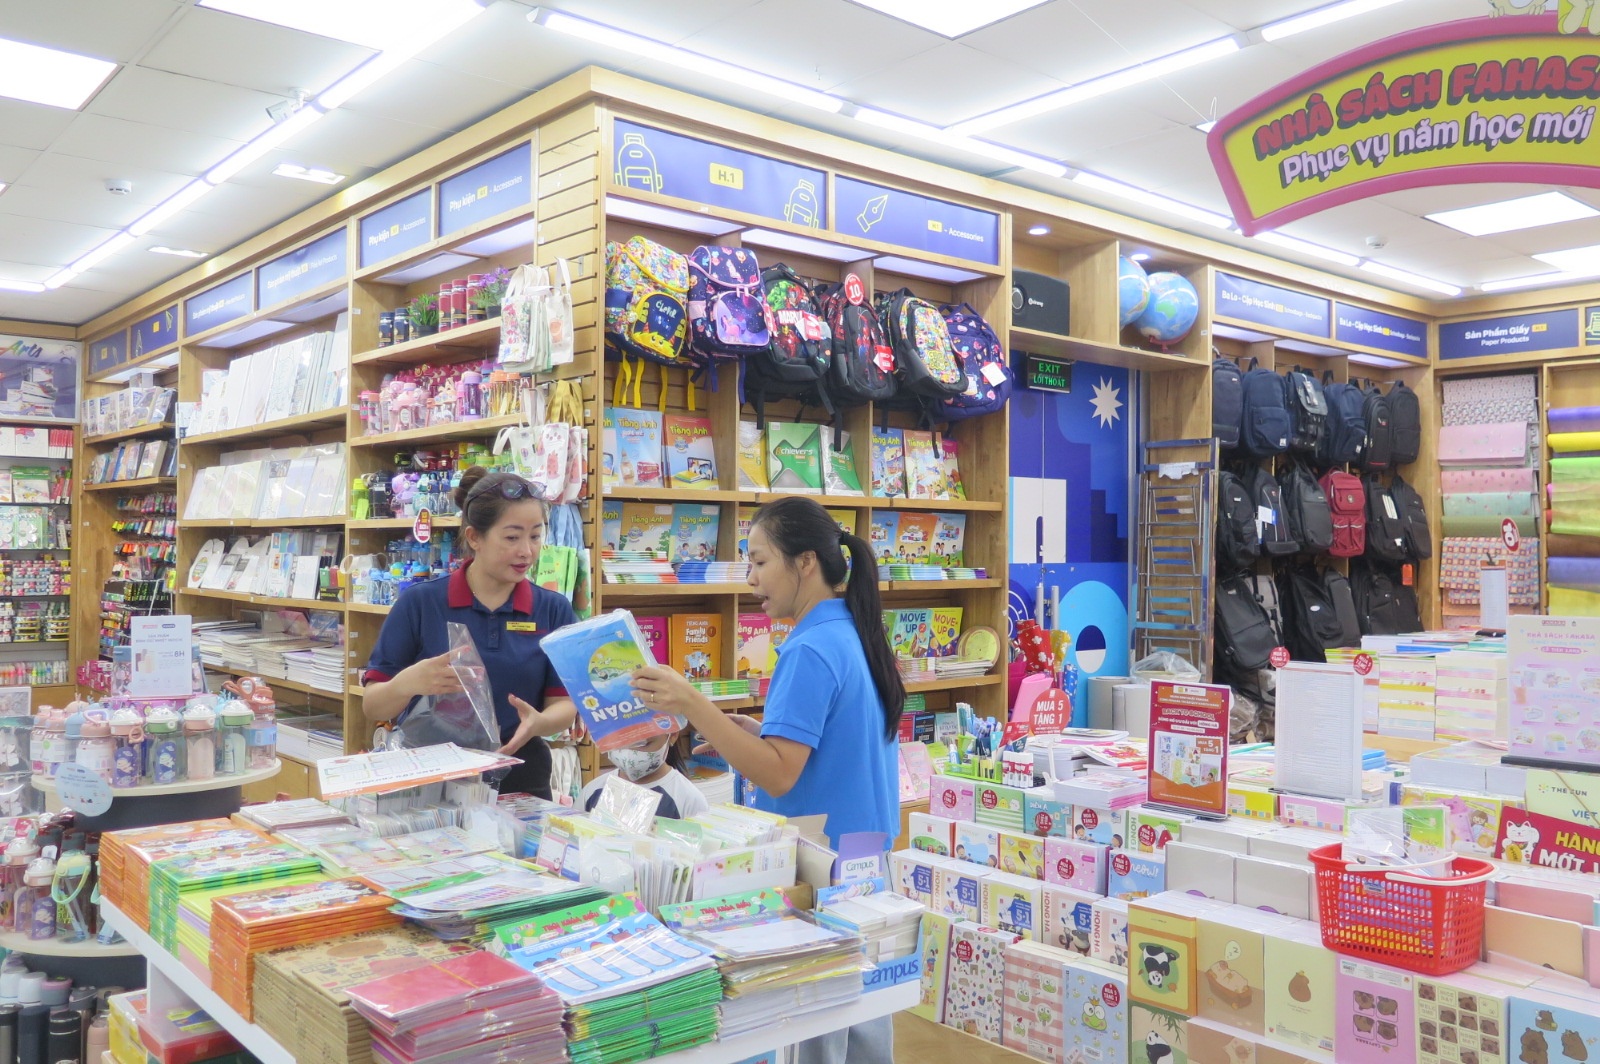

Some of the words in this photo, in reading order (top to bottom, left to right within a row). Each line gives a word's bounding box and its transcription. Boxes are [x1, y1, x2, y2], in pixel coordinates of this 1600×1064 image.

[1254, 93, 1333, 157] NHÀ
[1337, 72, 1443, 127] SÁCH
[1447, 55, 1600, 105] FAHAS
[1280, 145, 1349, 186] Phục
[1351, 133, 1389, 166] vụ
[1394, 118, 1459, 156] năm
[1463, 111, 1525, 151] học
[1527, 105, 1596, 144] mới
[718, 169, 736, 184] H.1
[450, 197, 461, 212] Phụ
[493, 175, 523, 194] Accessories
[403, 216, 426, 232] Accessories
[949, 228, 985, 242] Accessories
[849, 289, 860, 299] 10
[1222, 289, 1230, 300] Ba
[1230, 292, 1238, 302] Lo
[1264, 300, 1276, 311] Sinh
[778, 310, 803, 325] MARV
[1339, 317, 1346, 326] Ba
[1346, 319, 1352, 328] Lo
[1465, 330, 1482, 340] Sản
[1483, 326, 1508, 338] Phẩm
[1509, 324, 1530, 335] Giấy
[1500, 336, 1530, 344] Products
[8, 340, 43, 358] Arts
[1038, 362, 1061, 374] EXIT
[603, 418, 612, 428] nh
[618, 417, 639, 429] Tiếng
[642, 420, 657, 429] Anh
[669, 423, 692, 436] Tiếng
[693, 427, 708, 435] Anh
[873, 436, 886, 446] iếng
[888, 437, 900, 445] Anh
[907, 437, 925, 448] Tiếng
[775, 446, 813, 456] Achievers
[603, 511, 619, 520] Anh
[631, 515, 649, 524] Tiếng
[680, 515, 697, 524] Tiếng
[900, 612, 926, 623] MOVE
[686, 627, 706, 637] Family
[753, 627, 768, 635] Anh
[771, 622, 788, 632] Tiếng
[905, 624, 917, 633] UP
[937, 626, 947, 635] UP
[685, 635, 708, 644] Friends
[591, 697, 645, 723] TOÁN
[1036, 701, 1055, 712] MUA
[1058, 700, 1063, 711] 5
[1033, 712, 1055, 726] TẶNG
[1058, 713, 1062, 724] 1
[1162, 708, 1180, 716] BACK
[1188, 710, 1215, 721] SCHOOL
[1572, 809, 1597, 821] VIỆT
[846, 858, 874, 872] Campus
[1044, 921, 1050, 932] HA
[1094, 941, 1100, 953] HA
